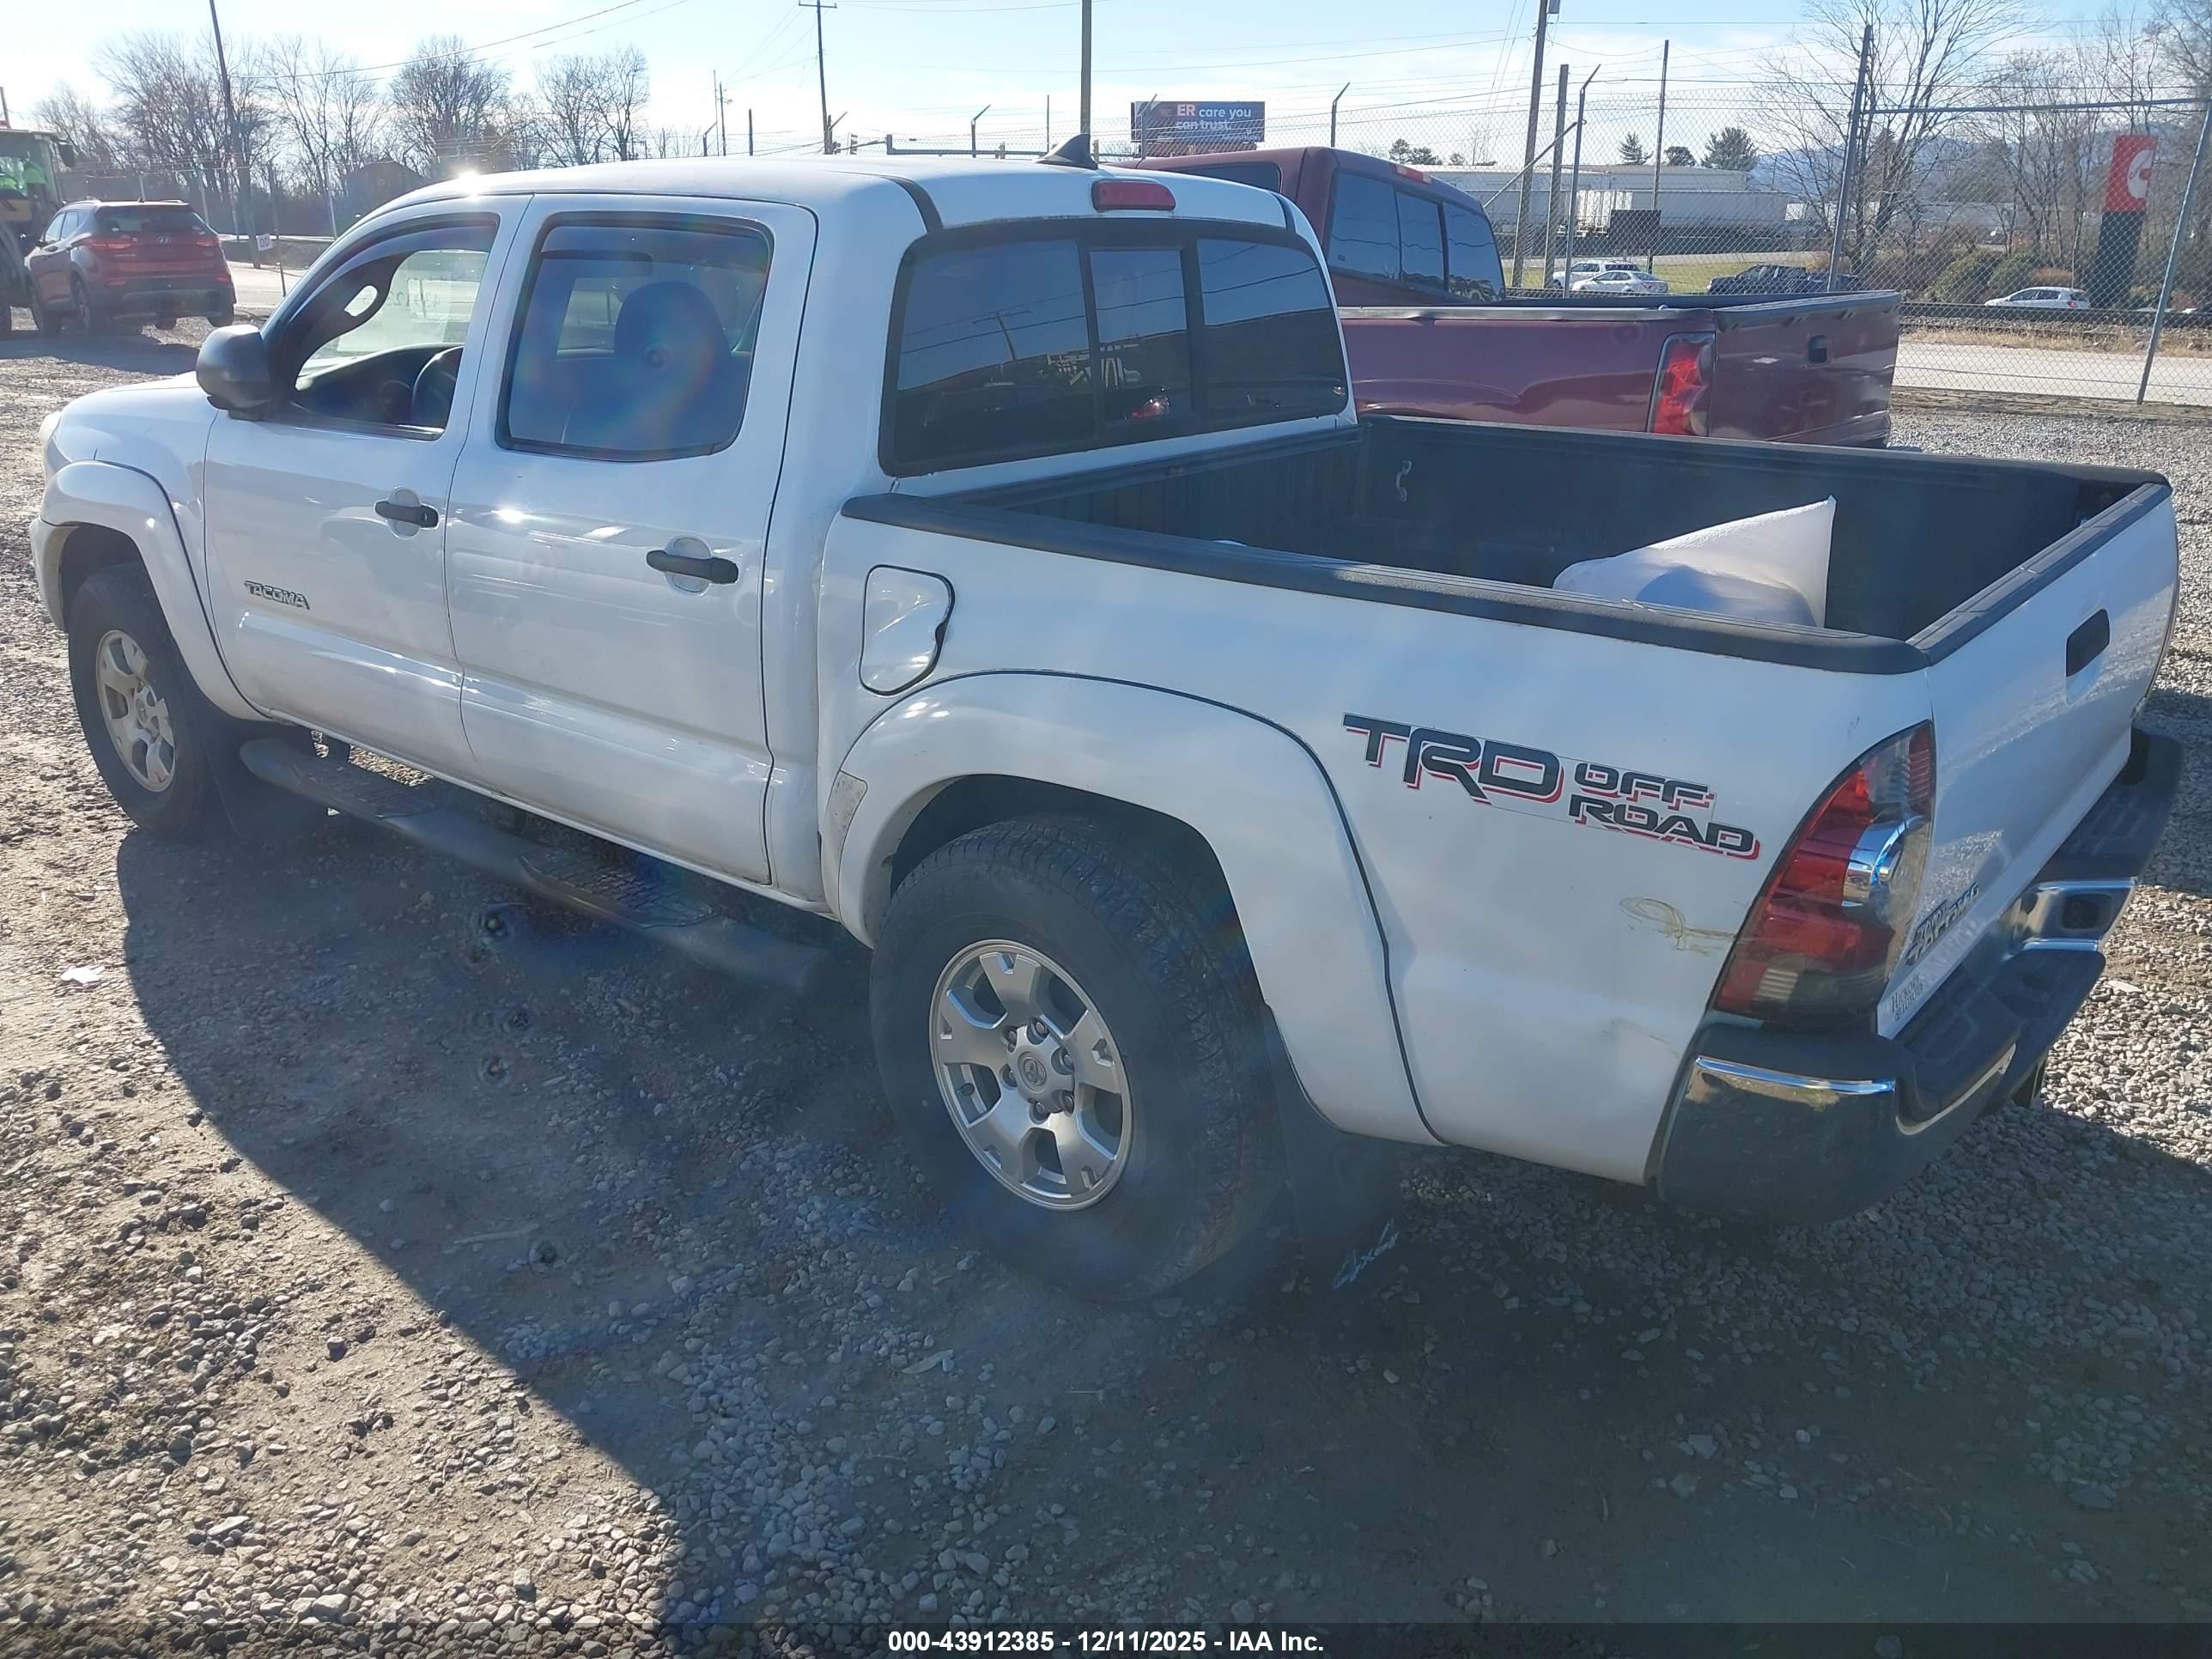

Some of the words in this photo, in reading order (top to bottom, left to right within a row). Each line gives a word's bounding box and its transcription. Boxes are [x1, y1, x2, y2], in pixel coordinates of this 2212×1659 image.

[1176, 121, 1198, 130] can
[1177, 104, 1195, 116] ER
[1199, 108, 1225, 117] care
[1229, 108, 1251, 119] you
[244, 580, 310, 611] TACOMA
[1342, 712, 1565, 805] TRD
[1574, 763, 1715, 810] OFF
[1568, 793, 1760, 860] ROAD
